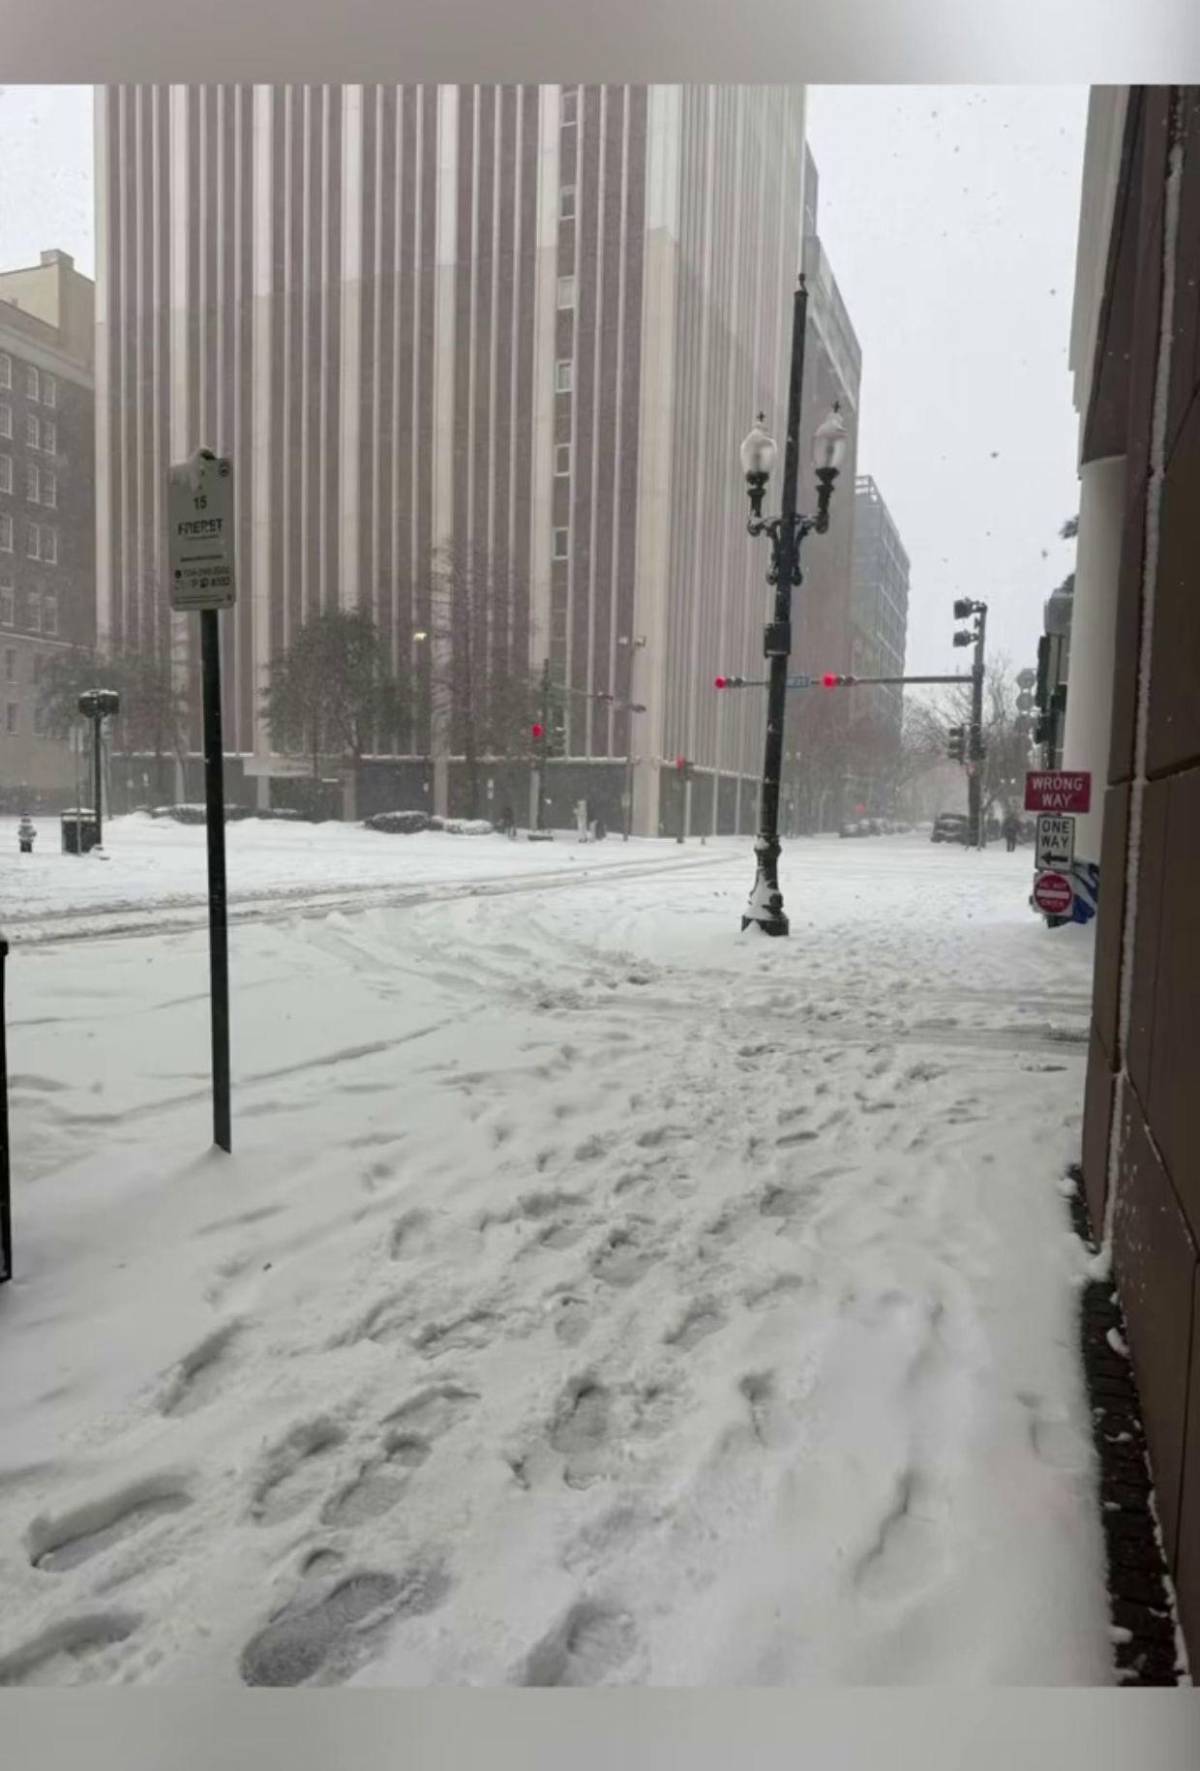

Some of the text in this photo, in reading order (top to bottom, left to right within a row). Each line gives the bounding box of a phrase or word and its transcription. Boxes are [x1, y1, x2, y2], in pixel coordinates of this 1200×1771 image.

[193, 495, 207, 510] 15
[1032, 776, 1083, 791] WRONG
[1042, 793, 1072, 808] WAY
[1042, 820, 1070, 834] ONE
[1041, 835, 1069, 848] WAY
